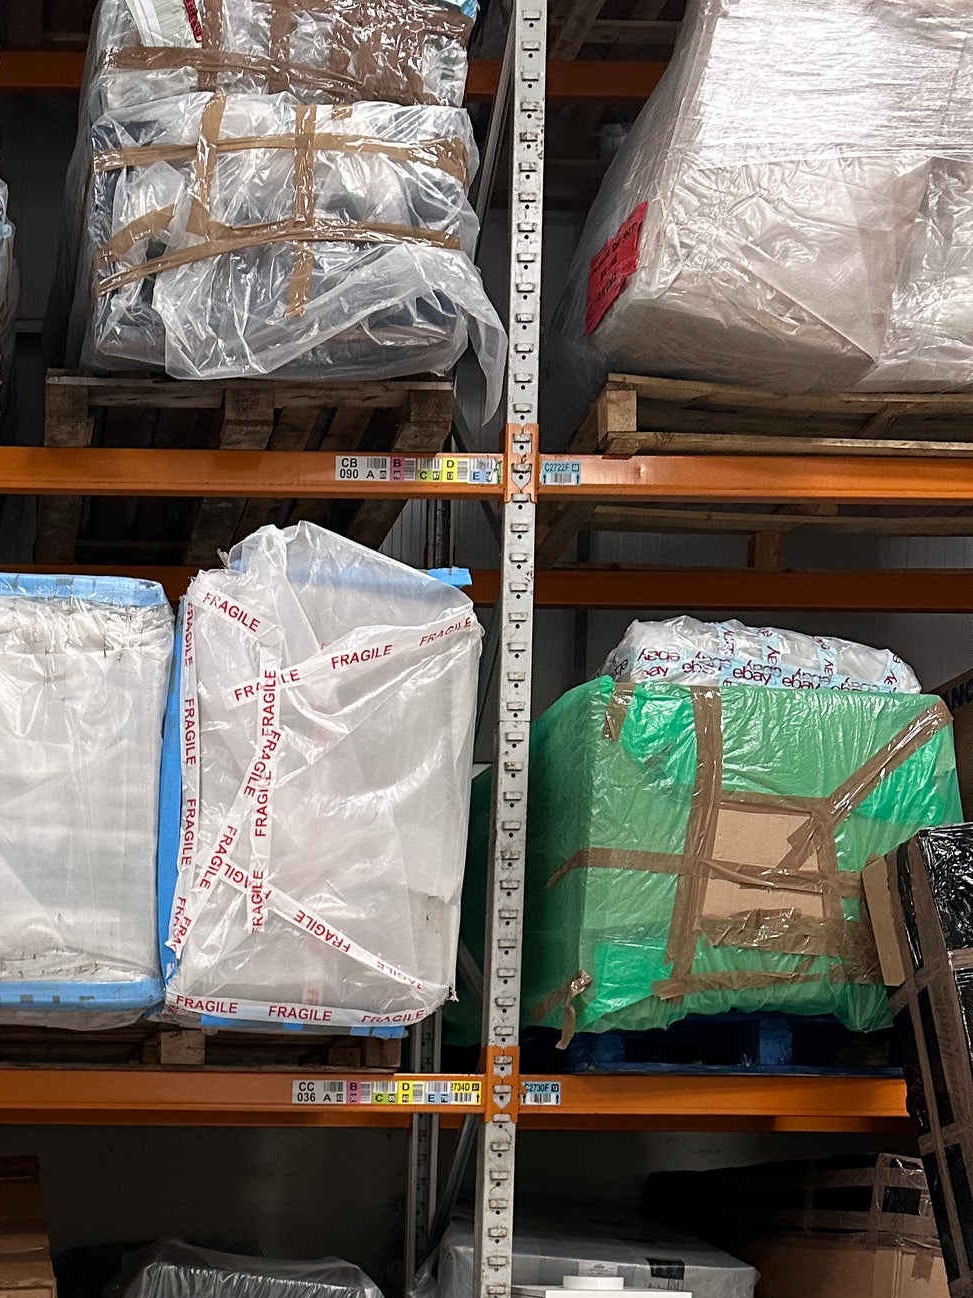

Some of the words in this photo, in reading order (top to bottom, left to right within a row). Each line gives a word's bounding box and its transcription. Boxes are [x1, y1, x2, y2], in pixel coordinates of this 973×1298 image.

[341, 457, 358, 468] CB
[393, 458, 402, 468] B
[446, 459, 455, 469] D
[544, 463, 570, 472] C2722F
[339, 468, 359, 479] 090
[366, 470, 375, 479] A
[419, 471, 428, 480] C
[472, 471, 480, 481] E
[204, 592, 261, 633] FRAGILE
[331, 644, 393, 670] FRAGILE
[419, 616, 472, 647] FRAGILE
[732, 665, 772, 686] ebay
[261, 670, 277, 737] FRAGILE
[184, 698, 196, 766] FRAGILE
[244, 730, 281, 798] FRAGILE
[181, 798, 196, 866] FRAGILE
[199, 825, 238, 890] FRAGILE
[293, 909, 351, 953] FRAGILE
[176, 995, 239, 1014] FRAGILE
[268, 1005, 333, 1022] FRAGILE
[361, 1009, 425, 1023] FRAGILE
[298, 1082, 315, 1091] CC
[350, 1082, 358, 1091] B
[402, 1082, 410, 1091] D
[297, 1092, 316, 1103] 036
[323, 1094, 332, 1103] A
[375, 1094, 384, 1103] C
[428, 1094, 436, 1103] E
